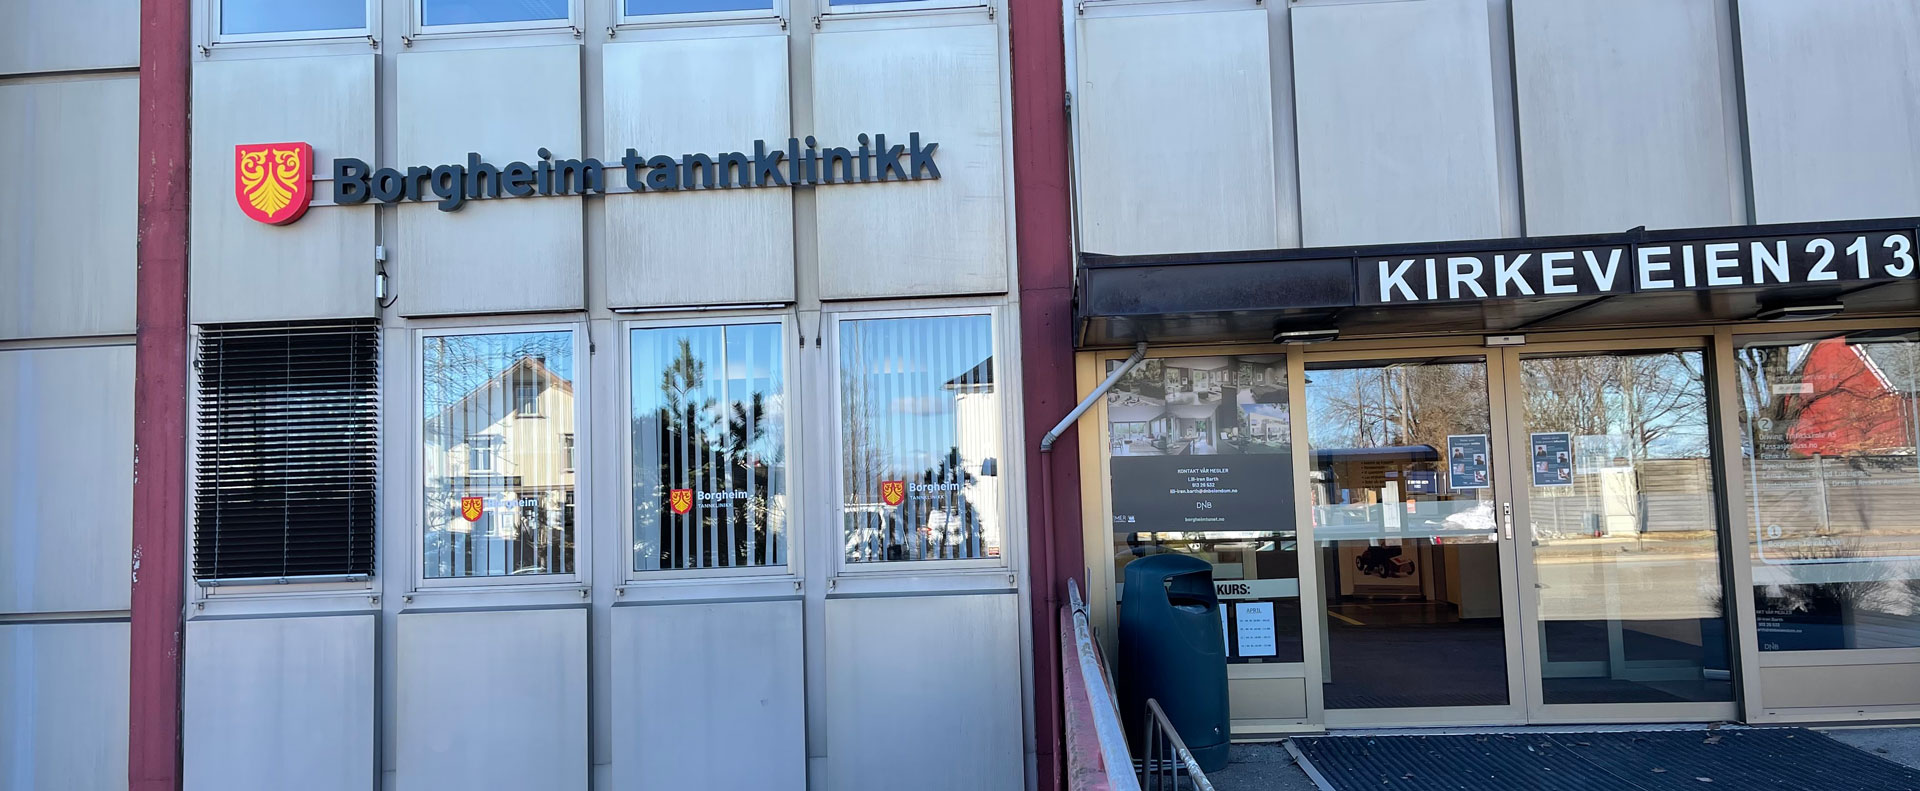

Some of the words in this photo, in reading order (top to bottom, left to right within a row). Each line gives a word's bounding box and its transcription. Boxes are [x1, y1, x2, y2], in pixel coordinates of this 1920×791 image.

[332, 147, 604, 213] Borgheim
[622, 132, 941, 194] tannklinikk
[1379, 239, 1790, 303] KIRKEVEIEN
[1806, 233, 1916, 281] 213
[909, 481, 960, 494] Borgheim
[697, 489, 748, 502] Borgheim
[1196, 500, 1212, 510] DNB
[1216, 583, 1251, 595] KURS:
[1764, 641, 1779, 651] DNB
